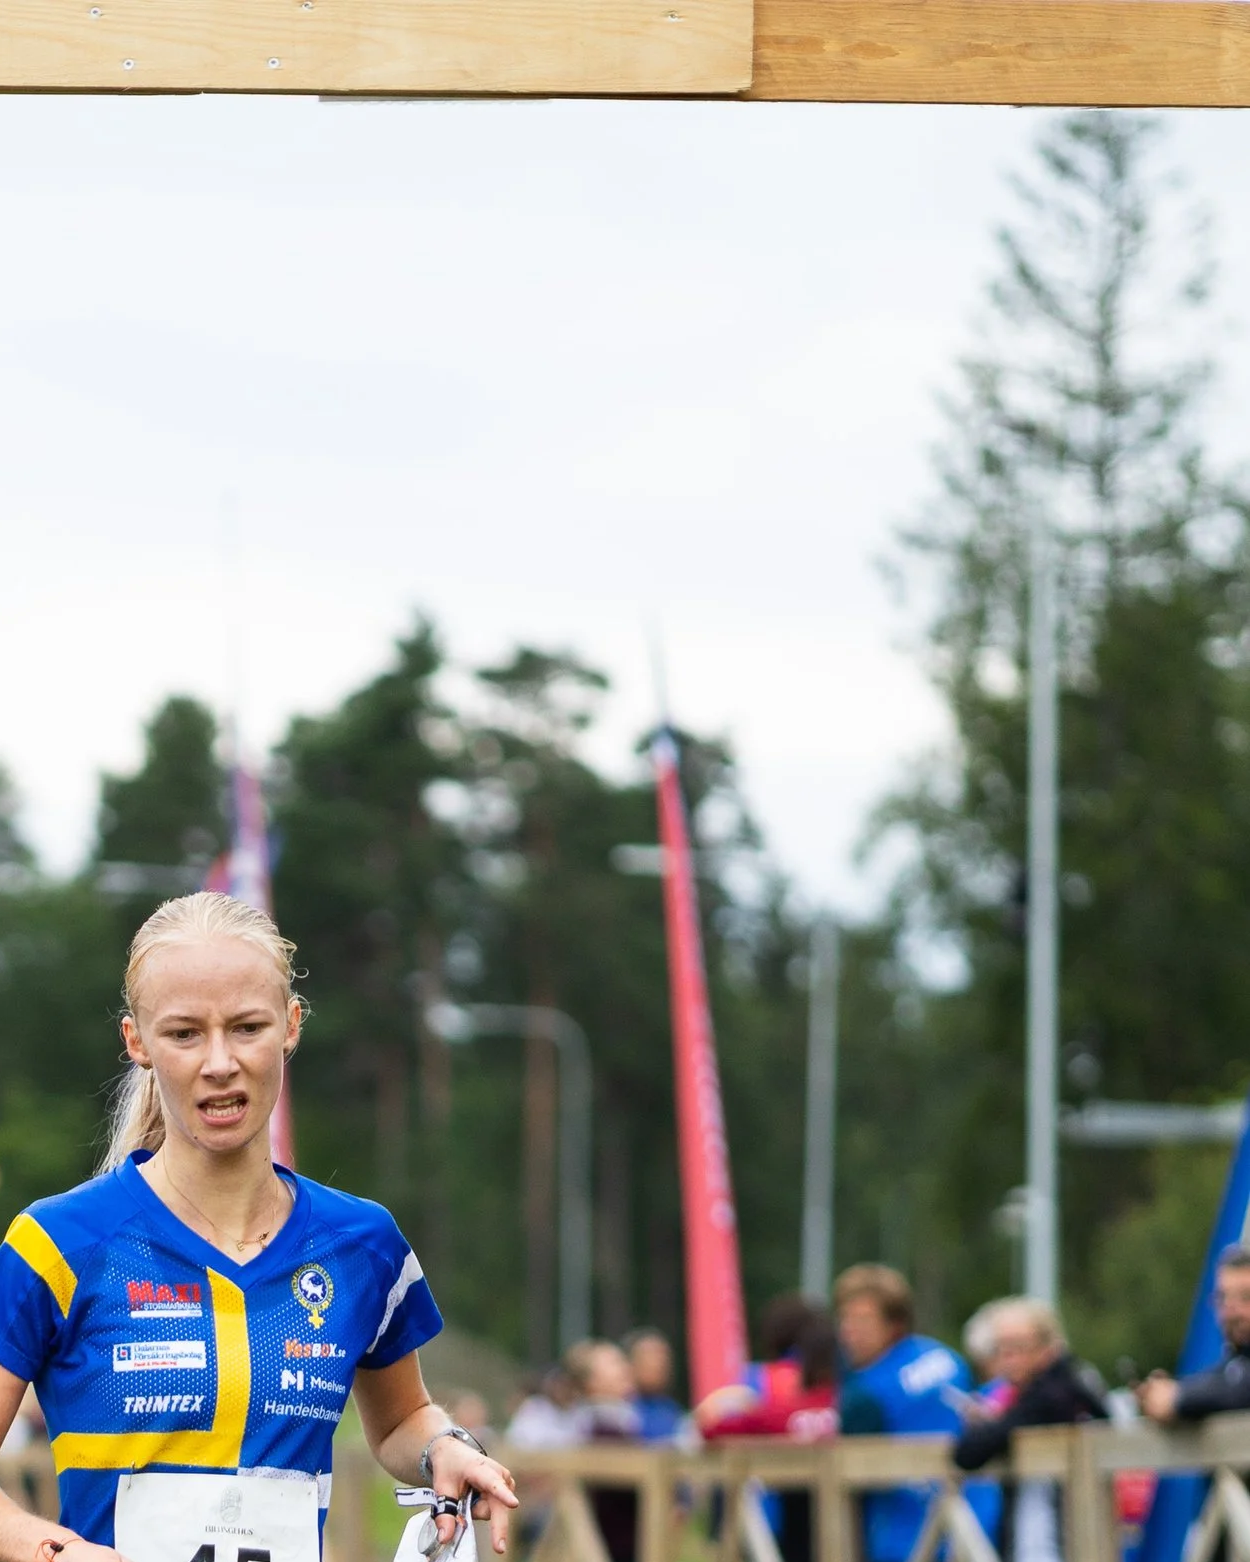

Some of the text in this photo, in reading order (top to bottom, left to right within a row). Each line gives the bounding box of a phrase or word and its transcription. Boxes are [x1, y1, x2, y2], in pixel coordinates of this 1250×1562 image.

[127, 1280, 201, 1302] MAXI
[310, 1375, 346, 1394] Moelven
[123, 1394, 205, 1414] TRIMTEX
